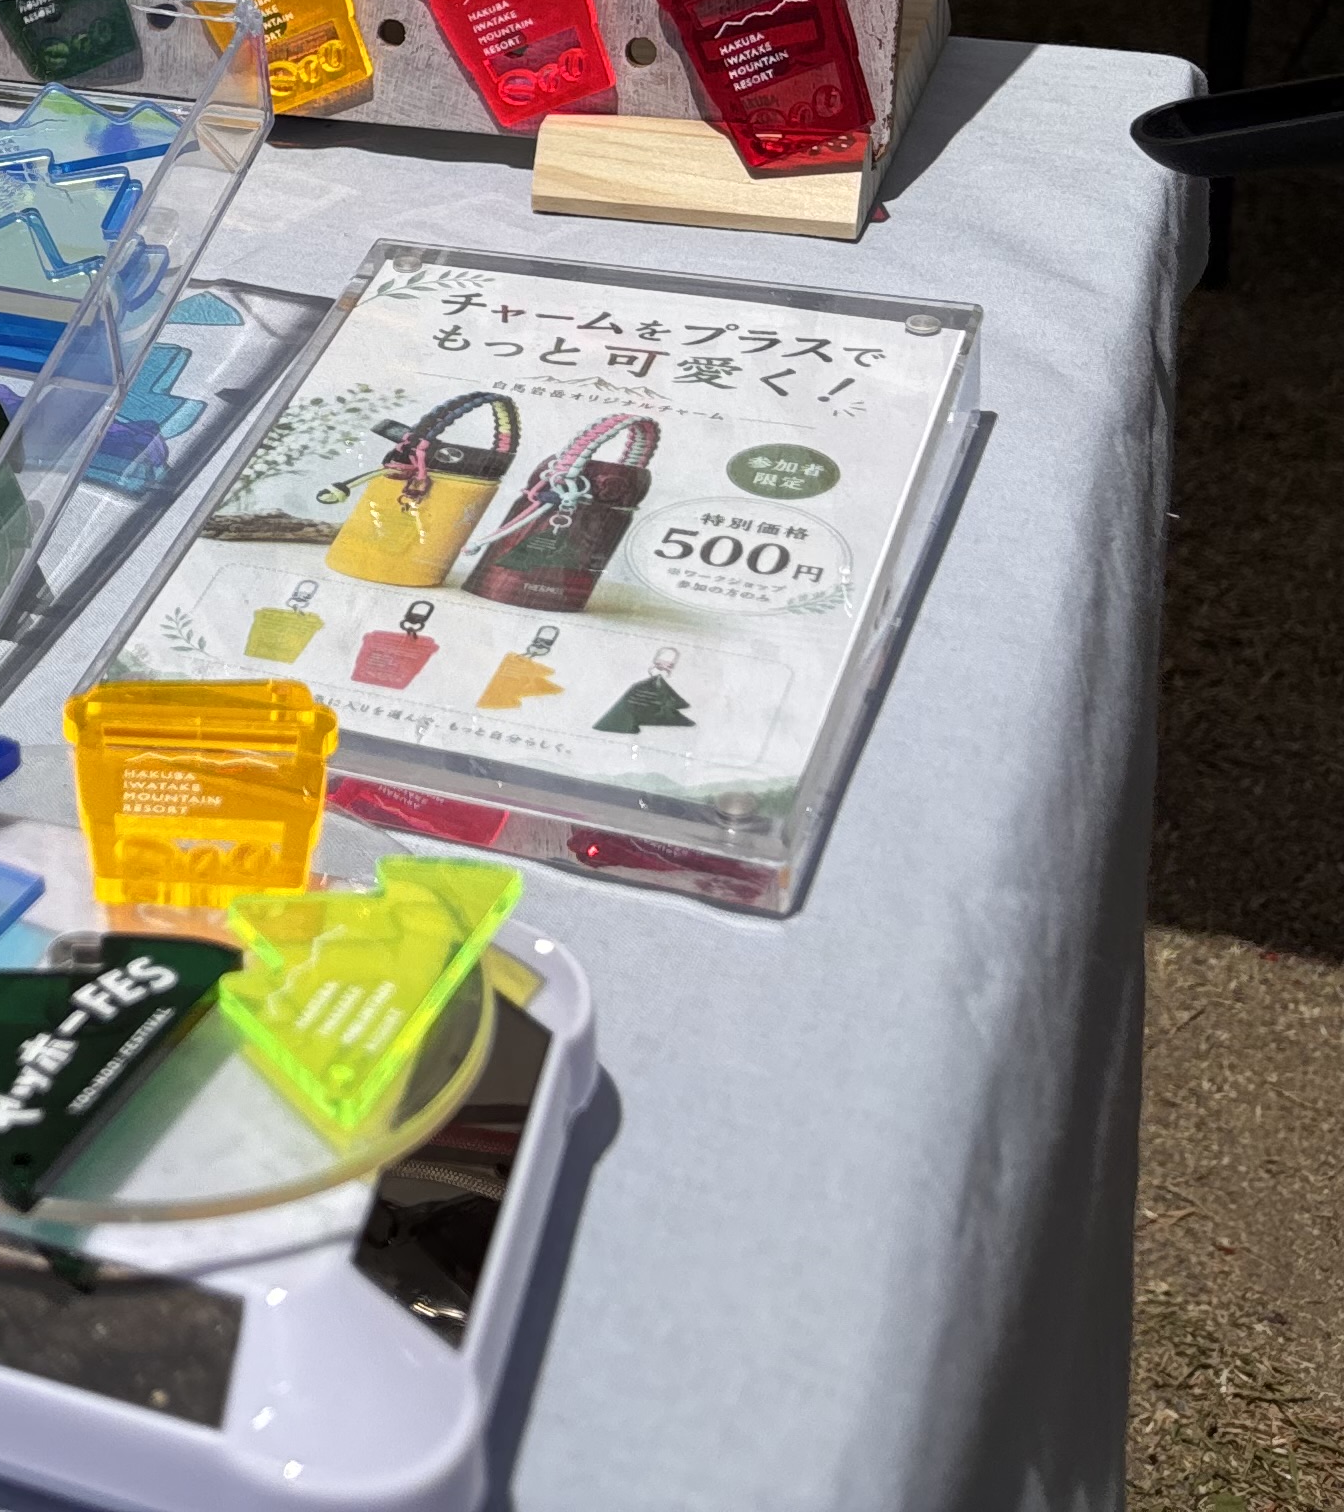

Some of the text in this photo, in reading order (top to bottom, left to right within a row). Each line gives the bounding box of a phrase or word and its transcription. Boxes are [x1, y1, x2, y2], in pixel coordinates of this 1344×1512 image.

[467, 0, 511, 22] HAKUBA
[472, 9, 518, 34] IWATAKE
[477, 17, 534, 45] MOUNTAIN
[719, 31, 765, 56] HAKUBA
[483, 35, 522, 57] RESORT
[723, 41, 773, 68] IWATAKE
[728, 49, 789, 80] MOUNTAIN
[733, 68, 775, 92] RESORT
[441, 291, 889, 368] チャームをプラスで
[431, 324, 858, 405] もっと可愛く！
[491, 379, 726, 422] 白馬岩岳オリジナルチャーム
[747, 455, 825, 479] 参加者
[752, 470, 805, 492] 限定
[701, 512, 810, 540] 特別価格
[652, 528, 825, 584] 500円
[675, 579, 771, 604] 参加の方のみ
[123, 769, 196, 781] HAKUBA
[123, 781, 201, 793] IWATAKE
[122, 792, 222, 806] MOUNTAIN
[122, 803, 188, 816] RESORT
